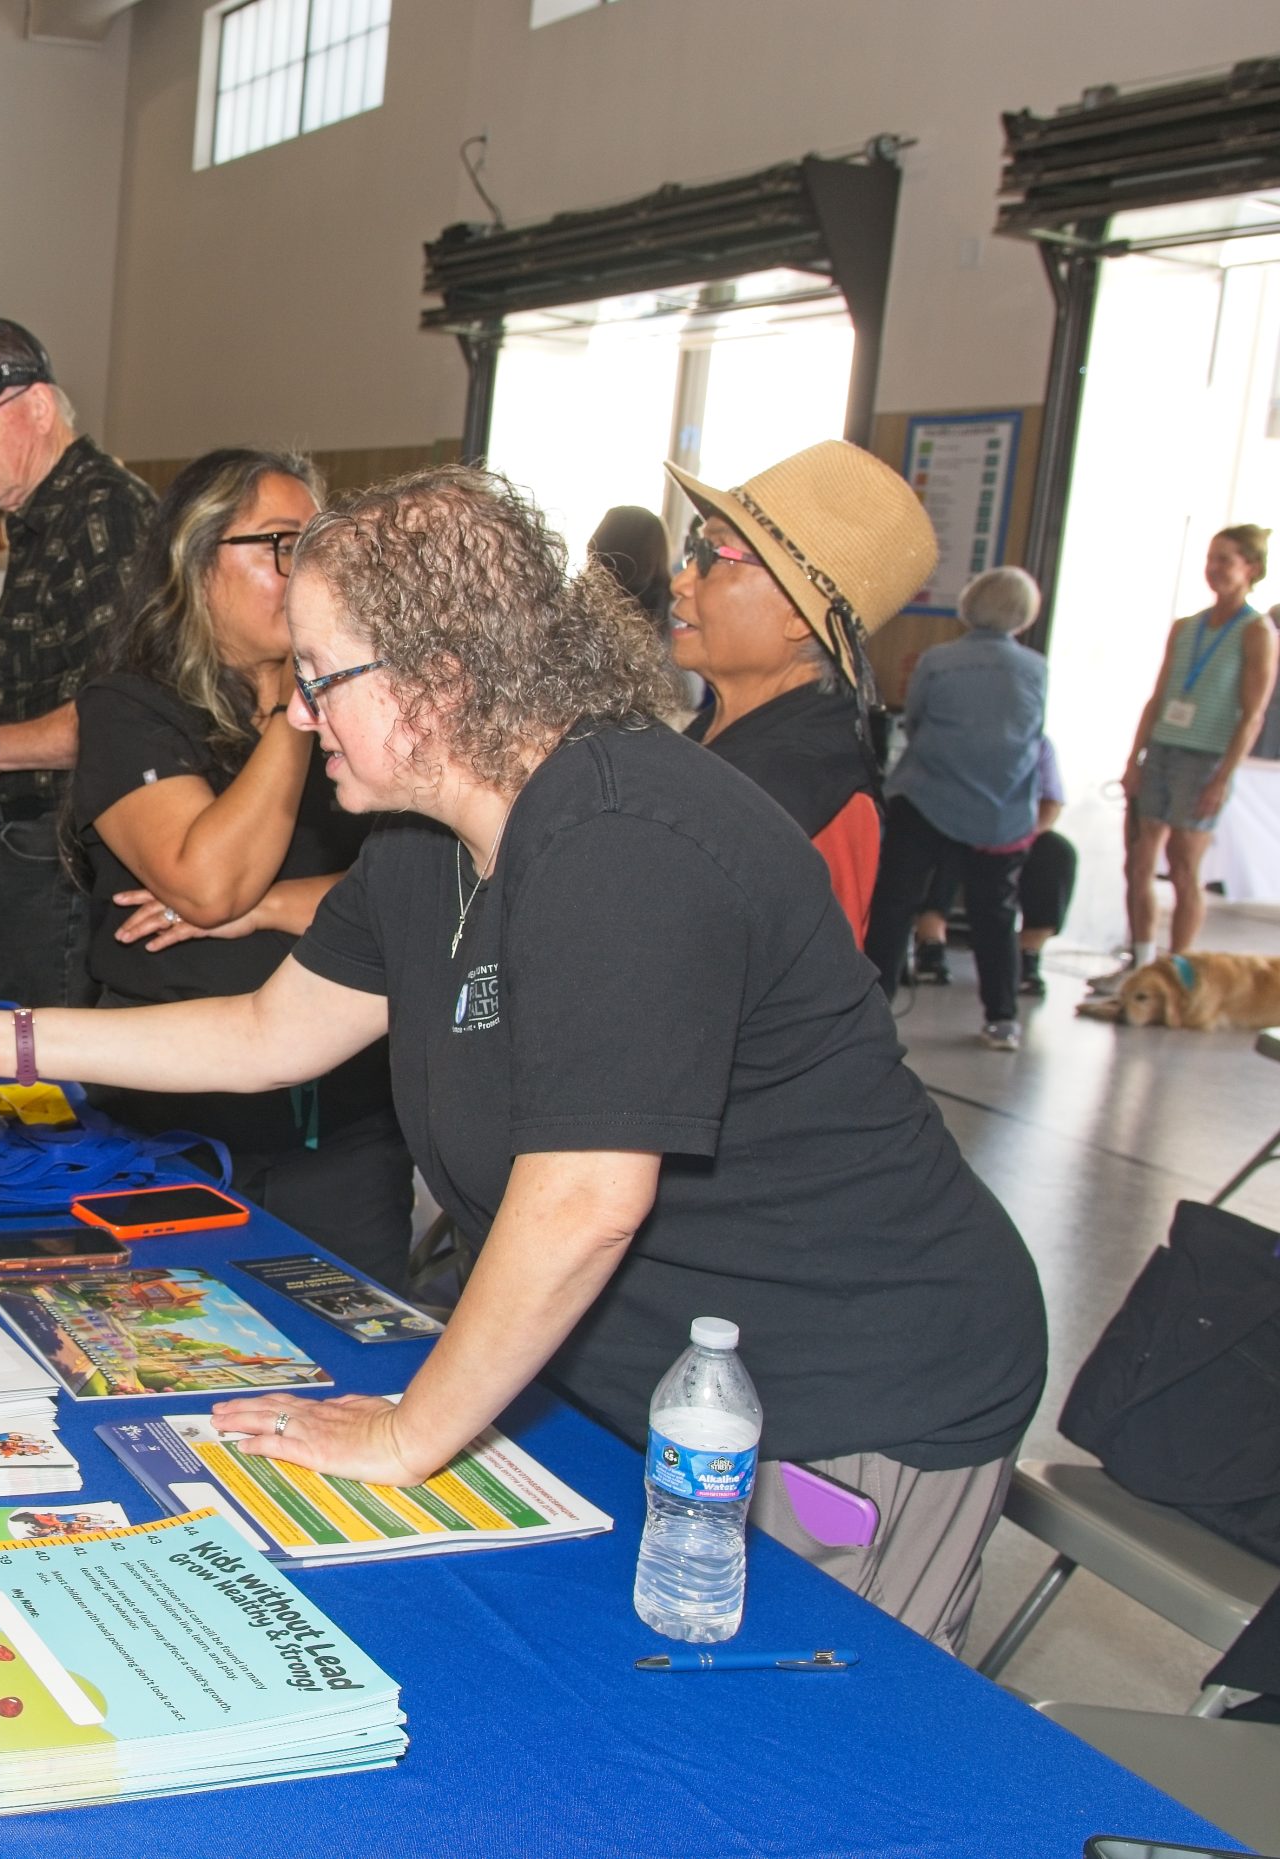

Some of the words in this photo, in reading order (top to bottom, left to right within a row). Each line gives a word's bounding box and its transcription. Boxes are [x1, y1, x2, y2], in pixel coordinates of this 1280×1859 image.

[698, 1474, 740, 1483] Alkaline
[147, 1535, 162, 1544] 43
[184, 1526, 200, 1536] 44
[34, 1550, 50, 1562] 40
[73, 1546, 88, 1556] 41
[110, 1541, 126, 1551] 42
[36, 1572, 51, 1586] sick.
[169, 1552, 220, 1580] Grow
[11, 1588, 24, 1598] My
[20, 1600, 40, 1618] Name:
[80, 1567, 104, 1592] learning,
[102, 1592, 118, 1603] and
[112, 1603, 139, 1630] behavior.
[213, 1580, 274, 1628] Healthy
[120, 1562, 142, 1580] places
[140, 1580, 160, 1597] where
[156, 1598, 182, 1620] children
[179, 1620, 192, 1634] live,
[192, 1634, 210, 1652] learn,
[208, 1652, 226, 1665] and
[218, 1665, 238, 1680] play.
[137, 1560, 156, 1572] Lead
[156, 1583, 180, 1602] poison
[178, 1602, 195, 1614] and
[190, 1614, 204, 1625] can
[200, 1626, 218, 1638] still
[212, 1636, 223, 1646] be
[220, 1646, 244, 1664] found
[238, 1664, 248, 1672] in
[246, 1672, 268, 1690] many
[190, 1540, 246, 1573] Kids
[237, 1574, 324, 1642] without
[304, 1644, 364, 1690] Lead
[50, 1570, 68, 1586] Most
[64, 1586, 88, 1609] children
[84, 1609, 100, 1622] with
[96, 1622, 114, 1636] lead
[105, 1637, 139, 1668] poisoning
[134, 1668, 154, 1686] don't
[150, 1686, 168, 1700] look
[164, 1701, 175, 1709] or
[171, 1710, 186, 1722] act
[94, 1566, 110, 1580] Even
[107, 1580, 120, 1590] low
[116, 1590, 136, 1608] levels
[138, 1614, 158, 1628] lead
[151, 1628, 168, 1641] may
[163, 1642, 185, 1660] affect
[202, 1688, 232, 1714] growth,
[266, 1630, 290, 1641] &
[275, 1643, 323, 1692] Strong!
